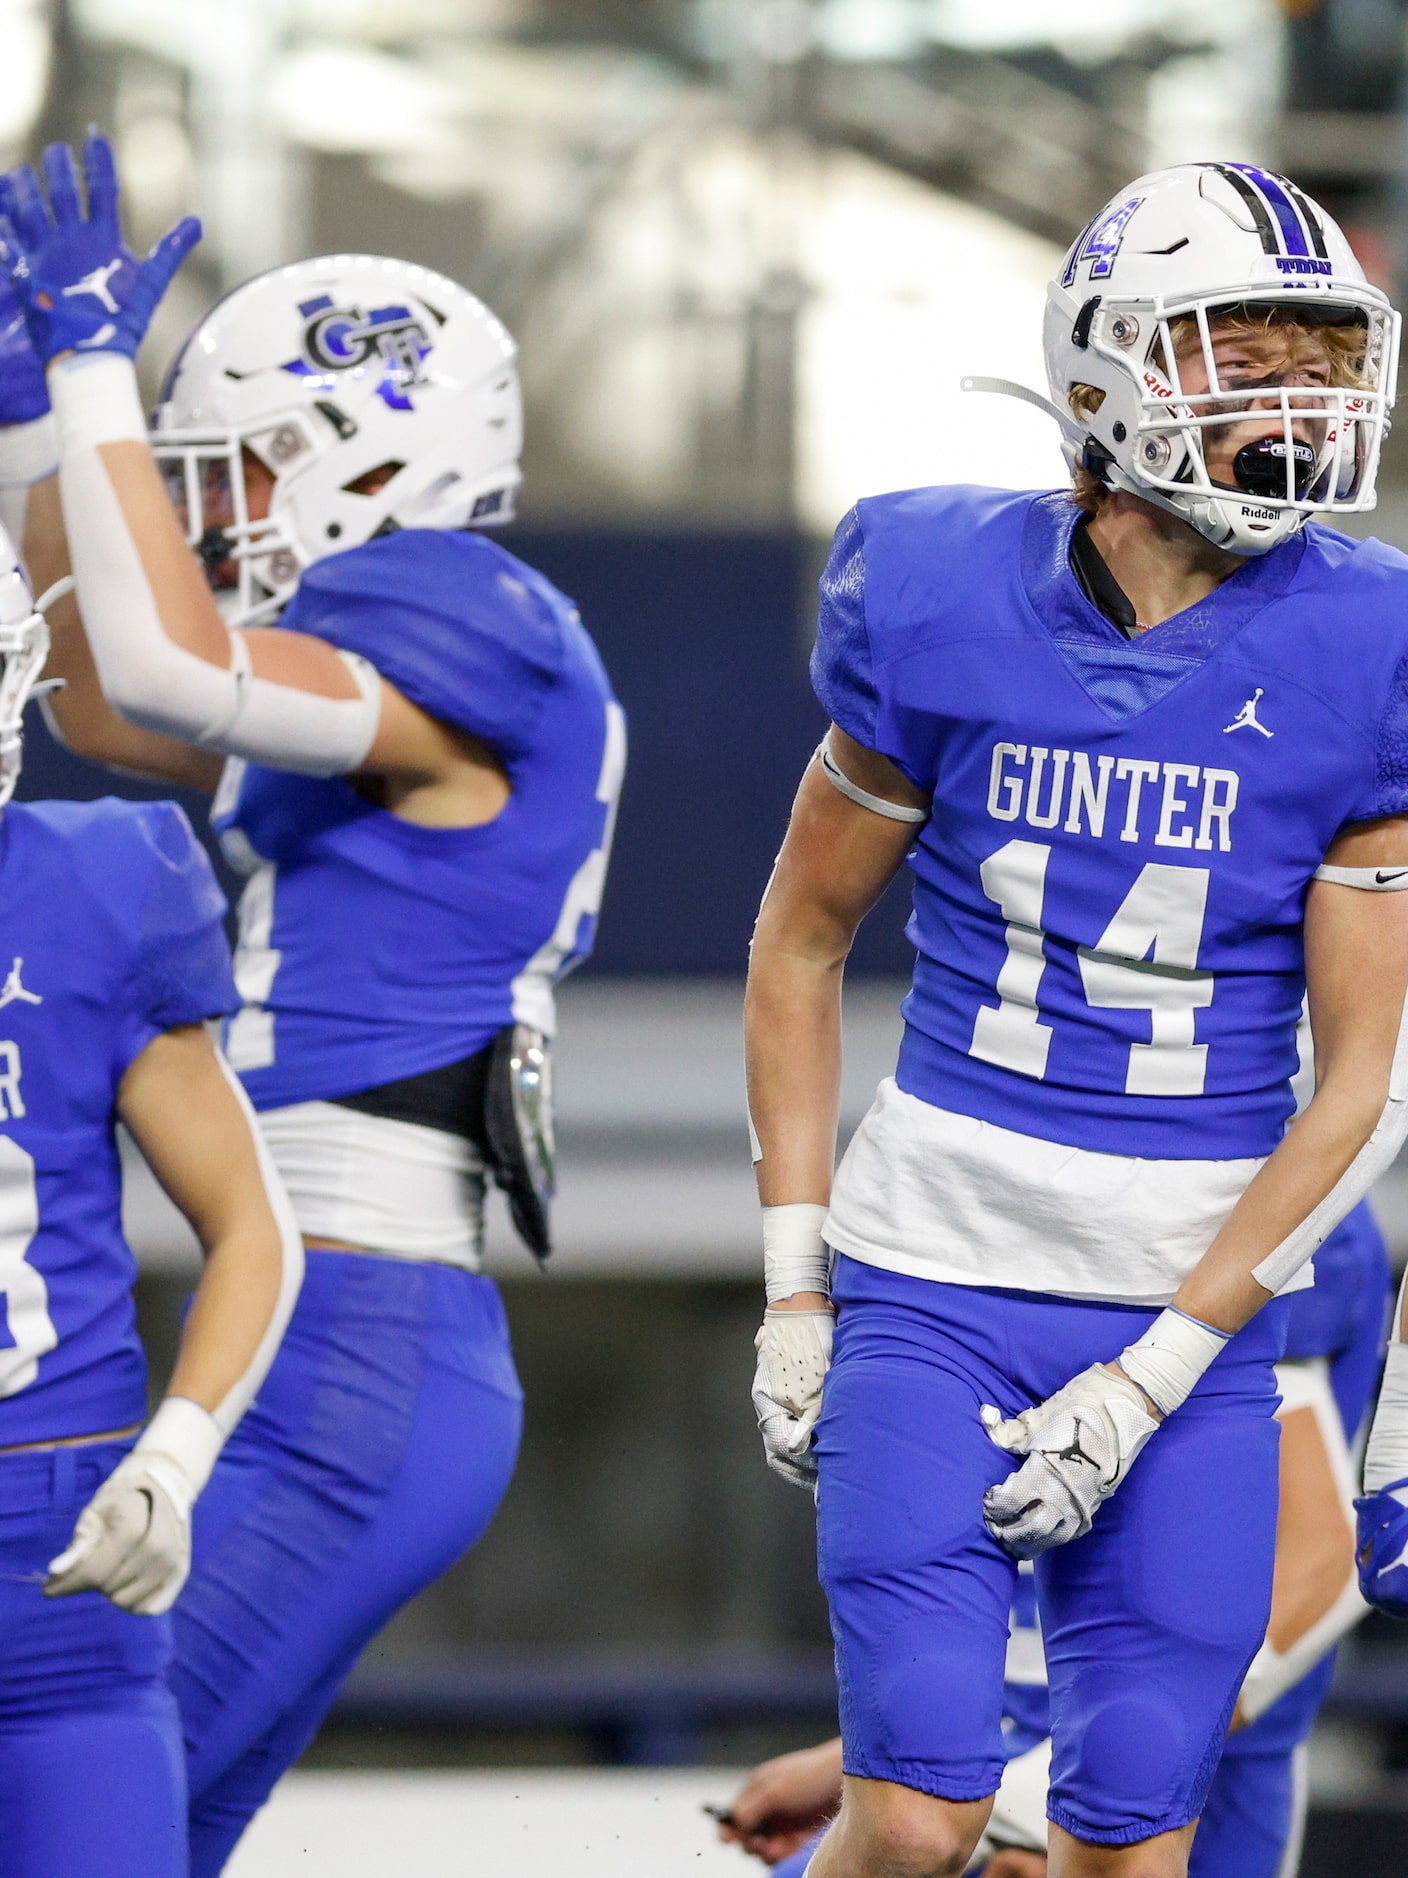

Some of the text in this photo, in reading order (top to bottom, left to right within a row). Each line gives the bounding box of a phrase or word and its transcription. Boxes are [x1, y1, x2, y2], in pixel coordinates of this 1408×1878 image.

[1241, 506, 1281, 520] Riddell
[986, 742, 1239, 852] GUNTER
[968, 839, 1214, 1096] 14
